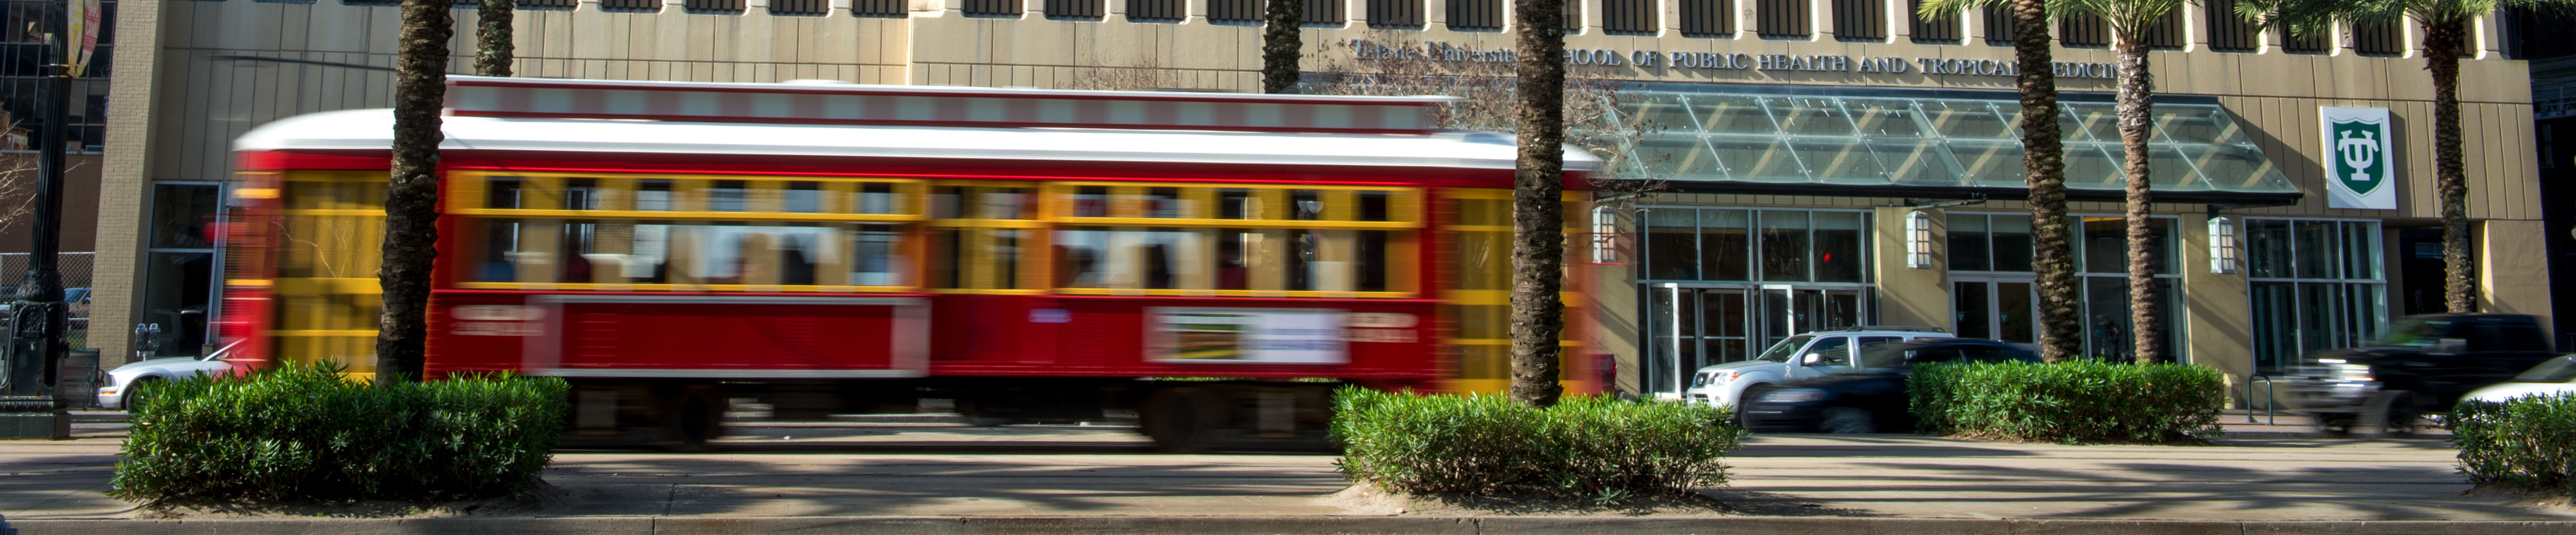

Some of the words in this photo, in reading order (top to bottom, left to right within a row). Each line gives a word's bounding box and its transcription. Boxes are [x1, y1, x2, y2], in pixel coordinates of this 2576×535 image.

[1563, 48, 1621, 66] HOOL
[1630, 49, 1659, 66] OF
[1668, 51, 1747, 69] PUBLIC
[1756, 54, 1847, 71] HEALTH
[1857, 56, 1907, 73] AND
[1916, 57, 2020, 76] TROPICAL
[2052, 62, 2119, 79] EDICIN
